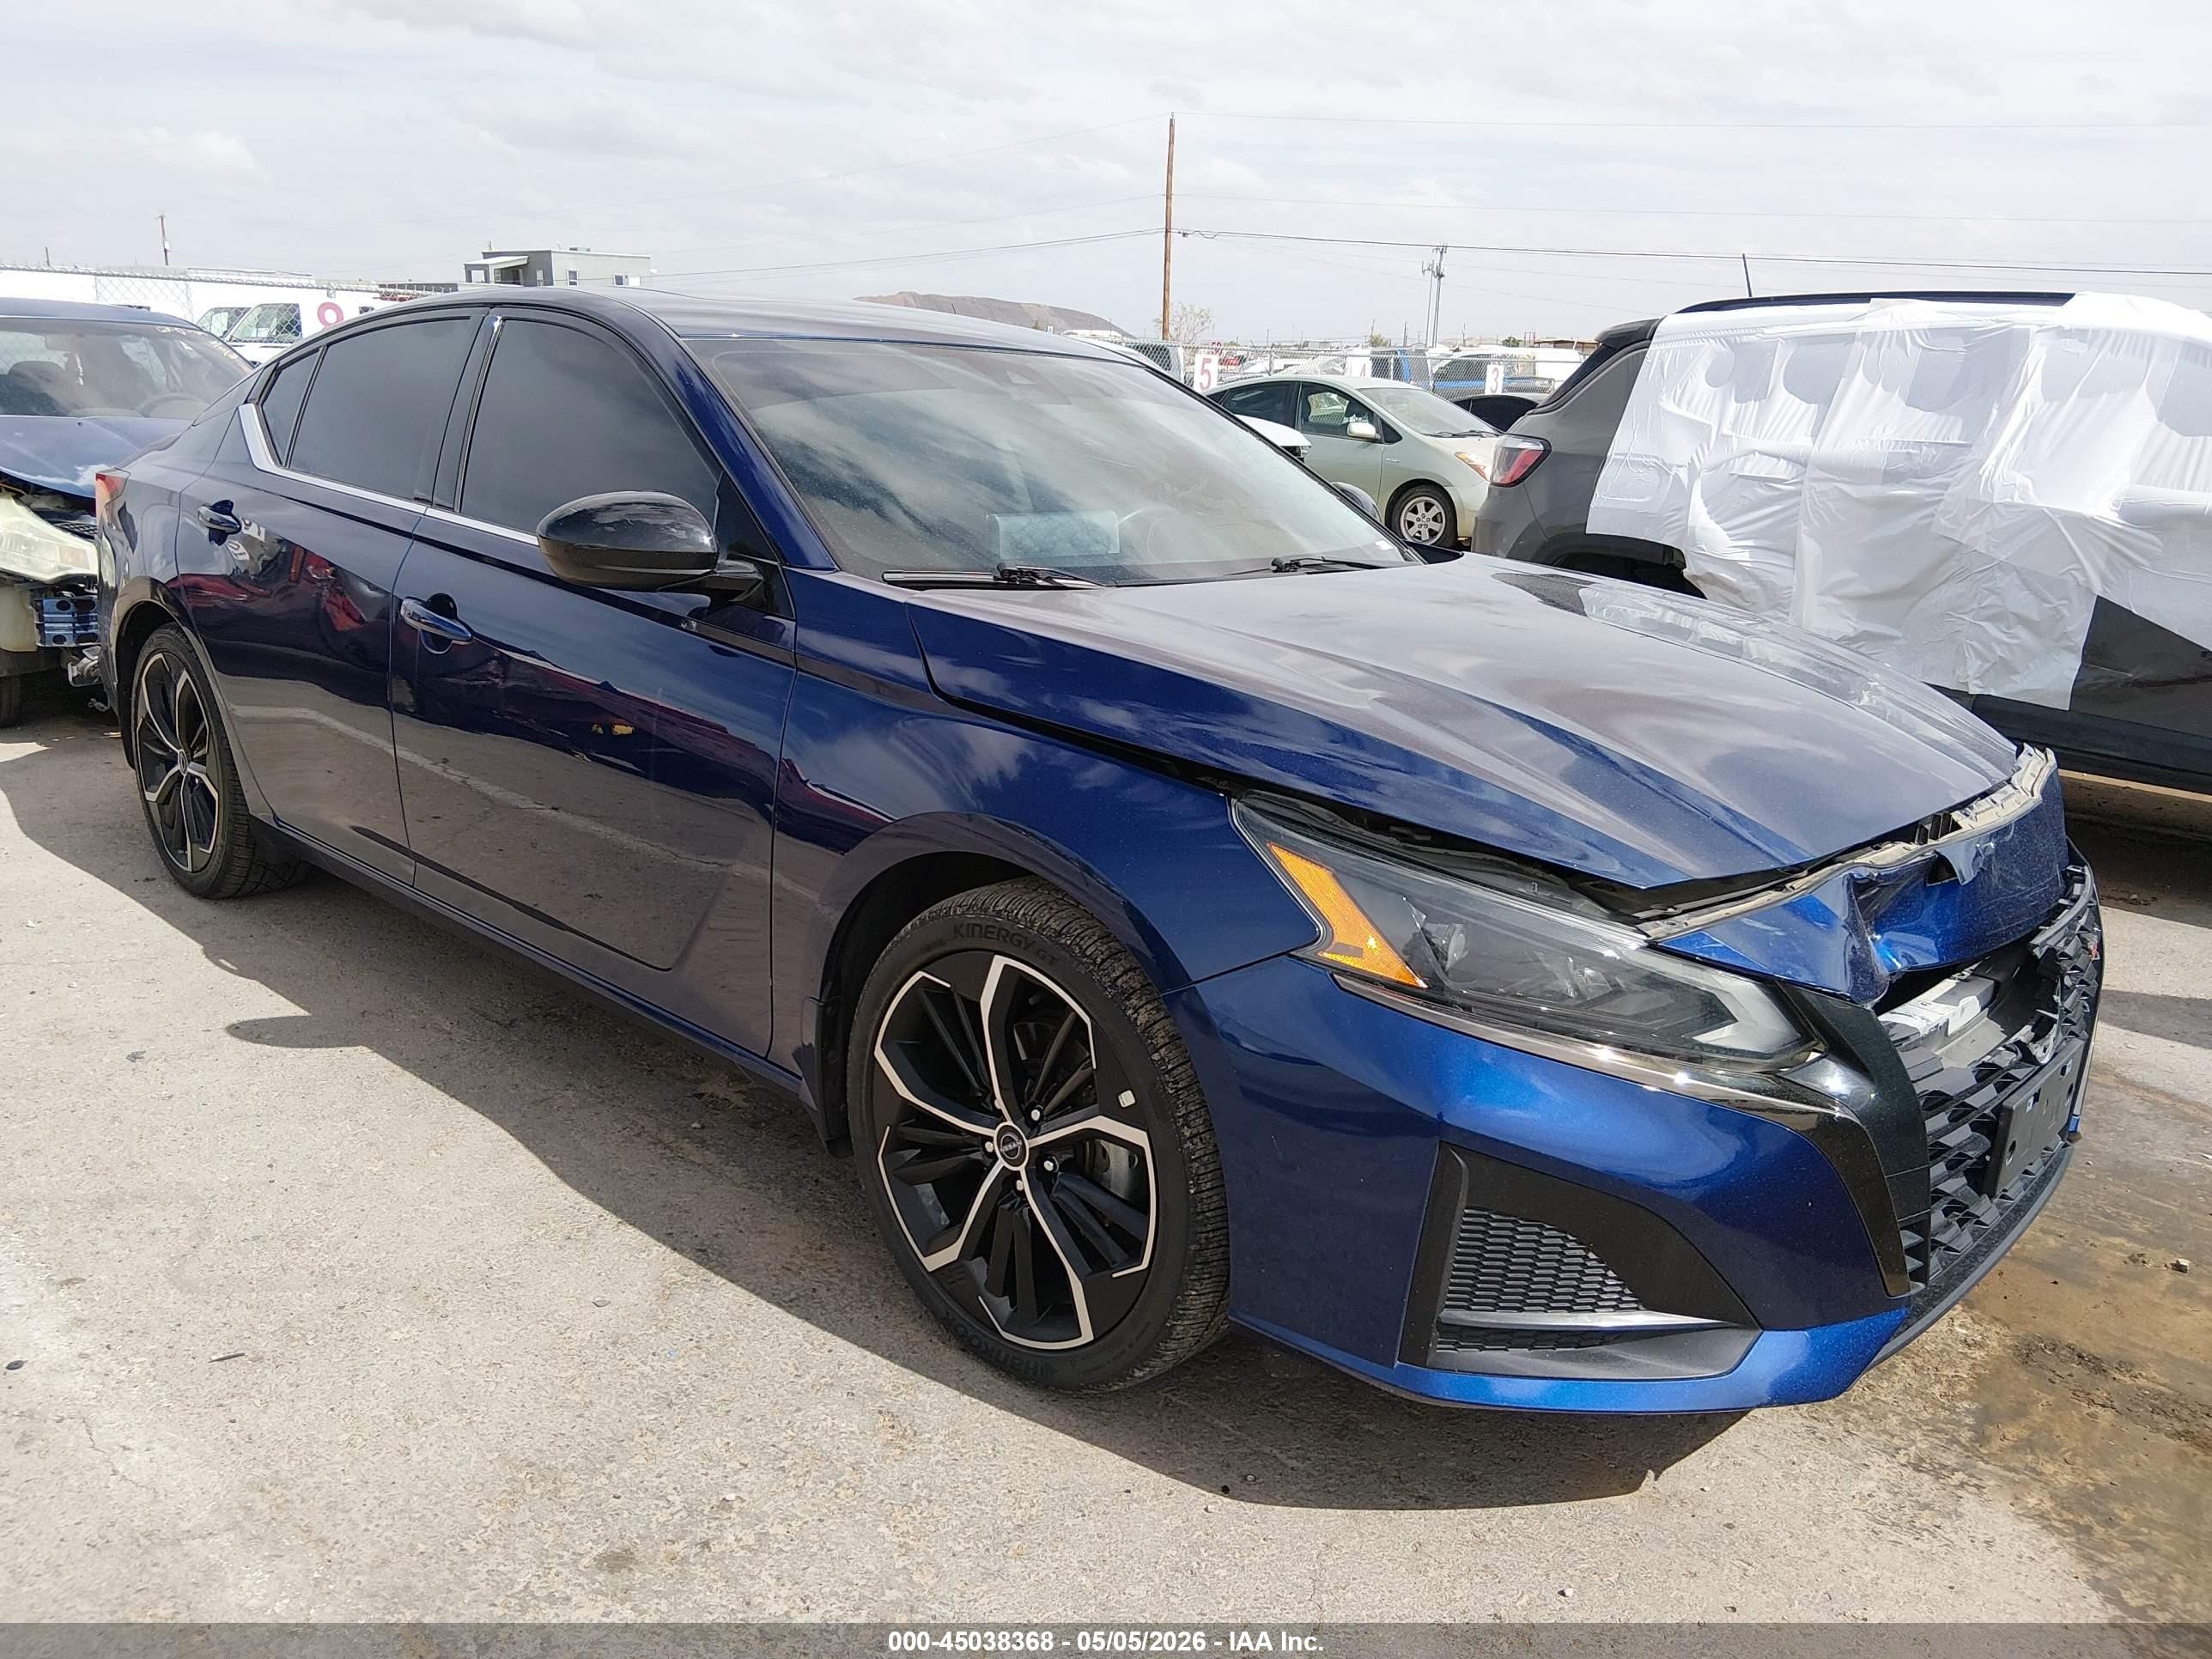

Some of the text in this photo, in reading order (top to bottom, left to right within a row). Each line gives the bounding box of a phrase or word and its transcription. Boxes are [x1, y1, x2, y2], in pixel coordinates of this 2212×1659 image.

[1199, 357, 1212, 392] 5
[1490, 367, 1499, 393] 3
[1036, 949, 1059, 966] GT
